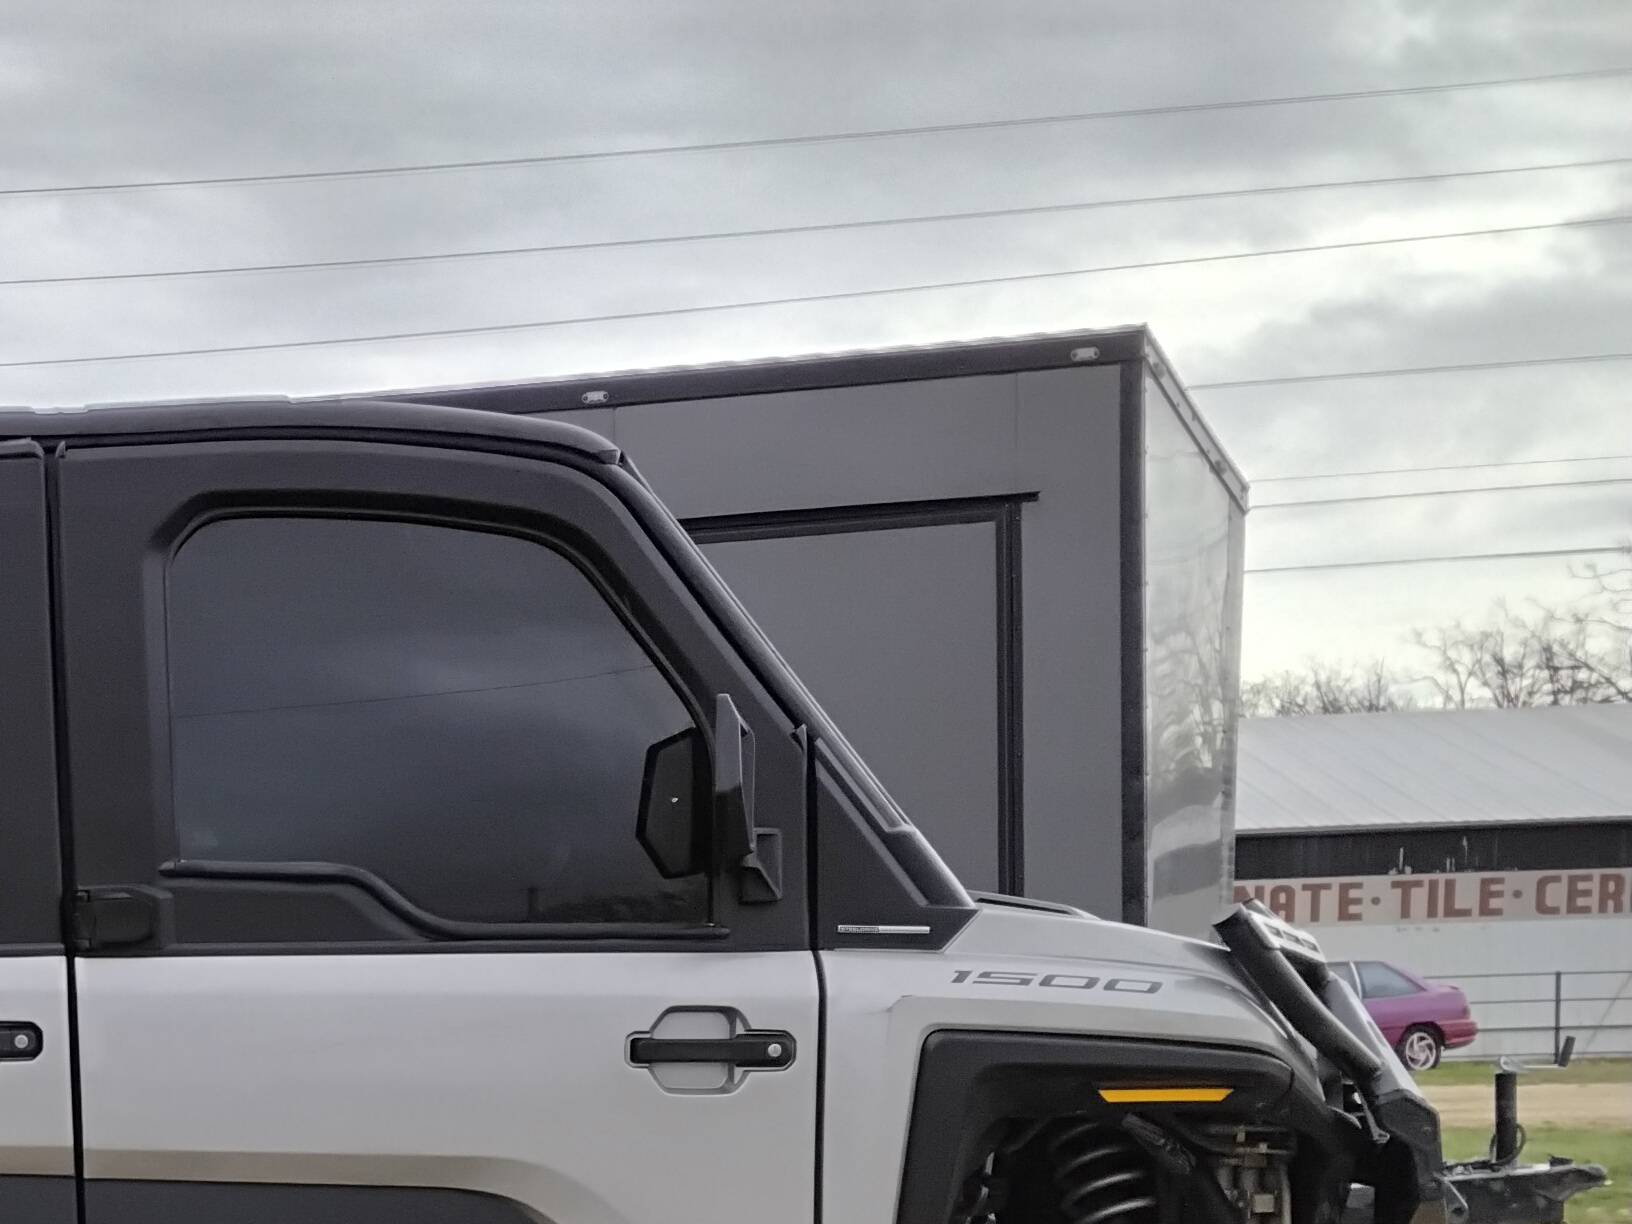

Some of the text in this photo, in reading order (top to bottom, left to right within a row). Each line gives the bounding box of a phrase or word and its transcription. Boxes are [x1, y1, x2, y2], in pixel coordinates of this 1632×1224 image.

[1391, 877, 1505, 919] TILE
[1535, 873, 1632, 915] CER
[950, 969, 1163, 994] 1500
